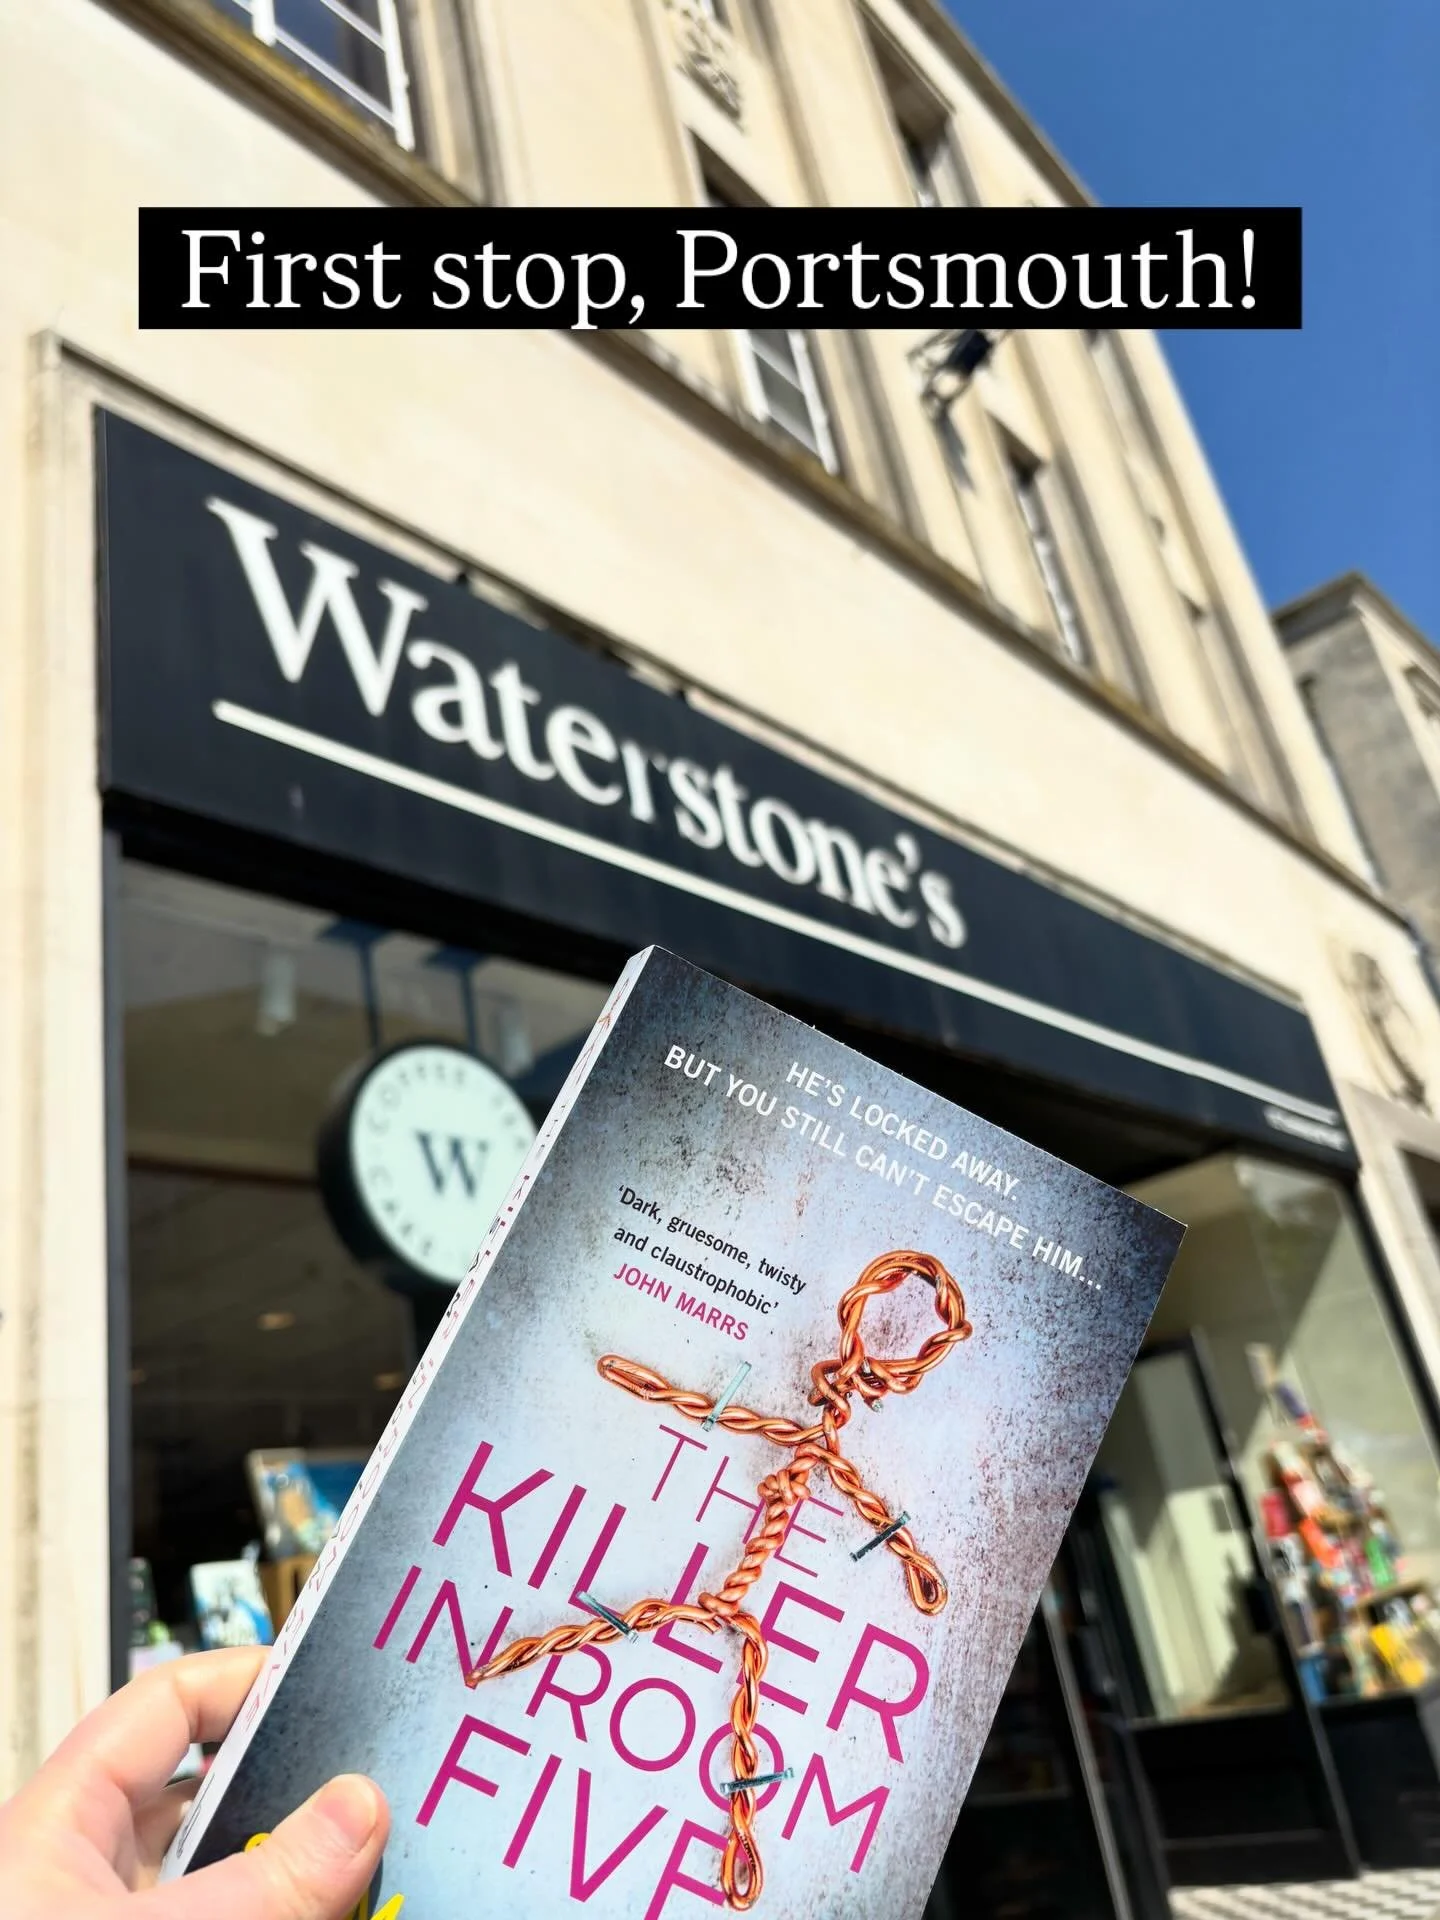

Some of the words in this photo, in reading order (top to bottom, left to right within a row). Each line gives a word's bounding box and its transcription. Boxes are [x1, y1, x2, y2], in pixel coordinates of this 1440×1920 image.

[206, 496, 968, 949] Waterstone's
[411, 1127, 490, 1198] W
[663, 1044, 721, 1087] BUT
[726, 1074, 778, 1117] YOU
[781, 1105, 847, 1157] STILL
[855, 1145, 931, 1197] CAN'T
[931, 1186, 1028, 1250] ESCAPE
[1033, 1236, 1102, 1289] HIM...
[785, 1061, 846, 1108] HE'S
[849, 1096, 948, 1161] LOCKED
[951, 1151, 1018, 1200] AWAY.
[613, 1227, 649, 1252] and
[651, 1246, 779, 1314] claustrophobic'
[613, 1263, 673, 1303] JOHN
[675, 1291, 749, 1341] MARRS
[618, 1184, 662, 1224] 'Dark,
[667, 1216, 752, 1270] gruesome,
[757, 1258, 807, 1295] twisty
[652, 1424, 845, 1578] THE
[433, 1441, 930, 1763] KILLER
[372, 1565, 513, 1690] IN
[525, 1640, 891, 1873] ROOM
